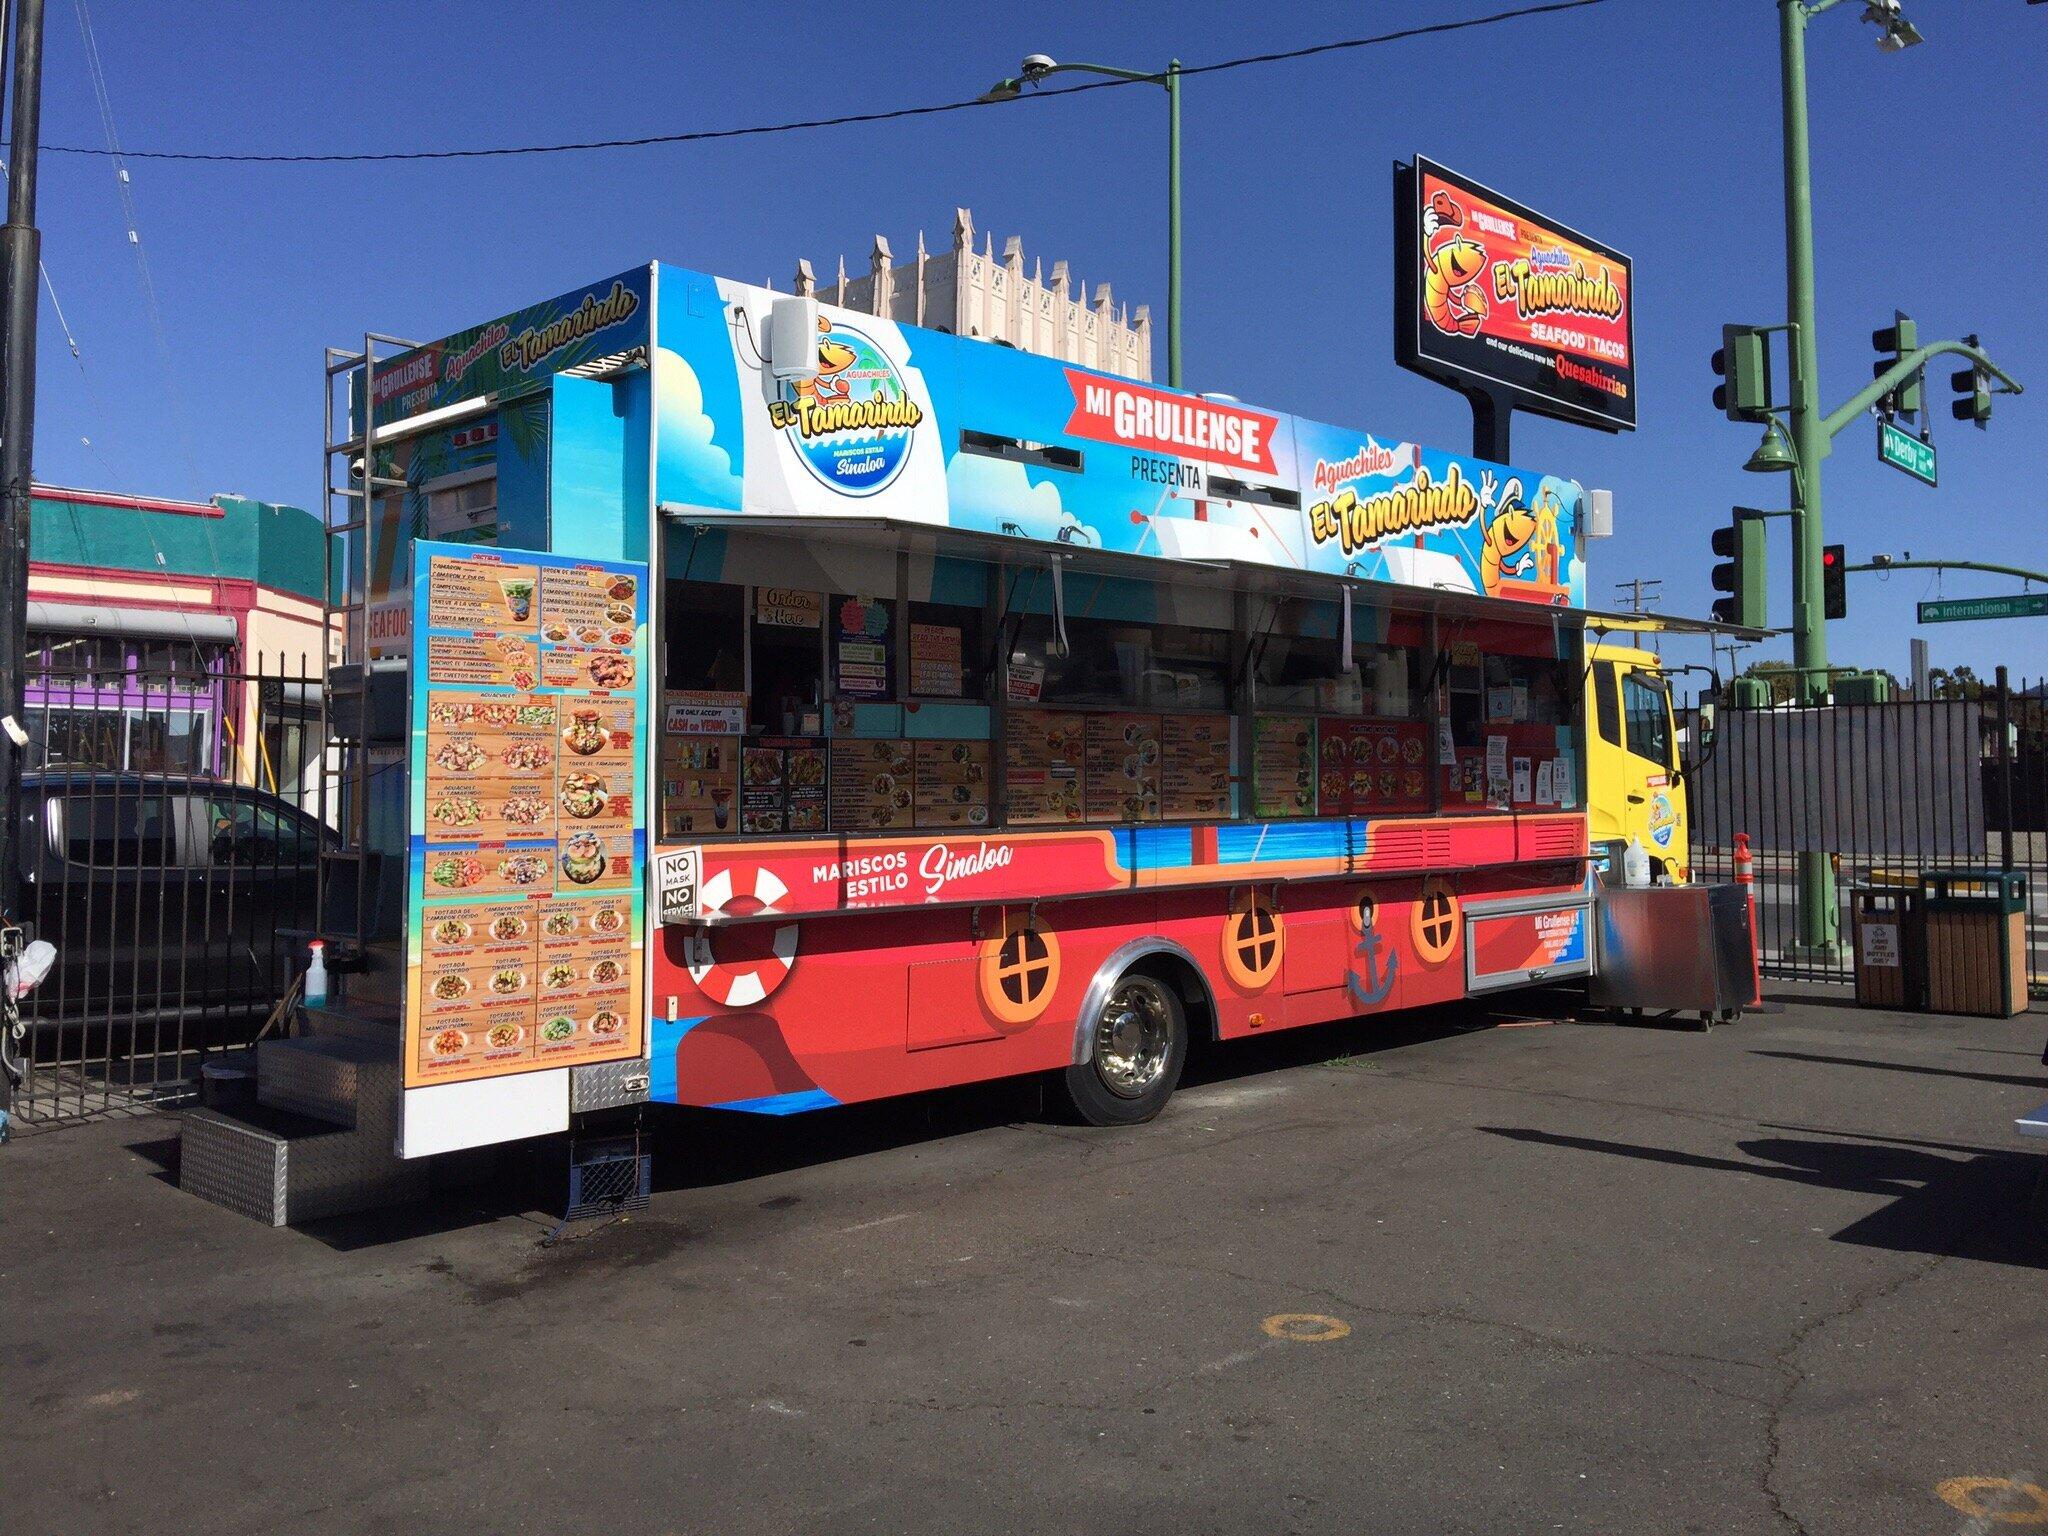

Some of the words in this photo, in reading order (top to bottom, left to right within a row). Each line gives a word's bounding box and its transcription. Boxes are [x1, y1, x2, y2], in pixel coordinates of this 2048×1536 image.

[1531, 246, 1571, 269] Aguachiles
[1494, 262, 1516, 300] EL
[1512, 262, 1622, 319] Tamarindo
[501, 343, 518, 369] EL
[517, 282, 636, 369] Tamarindo
[1530, 322, 1585, 349] SEAFOOD
[1593, 337, 1625, 360] TACOS
[446, 323, 507, 381] Aguachiles
[1486, 337, 1498, 348] and
[1498, 342, 1508, 351] our
[1508, 344, 1535, 360] delicious
[1535, 354, 1546, 364] new
[1556, 353, 1627, 398] Quesabirrias
[381, 353, 432, 398] GRULLENSE
[846, 369, 890, 379] AGUACHILES
[402, 382, 438, 411] PRESENTA
[768, 401, 797, 429] EL
[794, 390, 923, 438] Tamarindo
[1085, 385, 1111, 418] MI
[1113, 391, 1261, 463] GRULLENSE
[833, 448, 864, 458] MARISCOS
[865, 446, 884, 455] ESTILO
[836, 456, 886, 476] Sinaloa
[1895, 435, 1917, 470] Derby
[1131, 456, 1201, 490] PRESENTA
[1314, 446, 1394, 493] Aguachiles
[1310, 502, 1338, 545] EL
[1333, 466, 1478, 555] Tamarindo
[767, 588, 812, 609] Order
[1943, 603, 2011, 617] International
[775, 609, 804, 625] Here
[668, 718, 689, 732] CASH
[700, 719, 727, 732] VENMO
[666, 857, 689, 874] NO
[666, 874, 690, 886] MASK
[813, 851, 907, 884] MARISCOS
[919, 842, 1014, 894] Sinaloa
[666, 888, 690, 906] NO
[846, 873, 909, 898] ESTILO
[1535, 916, 1543, 930] Mi
[1543, 914, 1571, 928] Grullense
